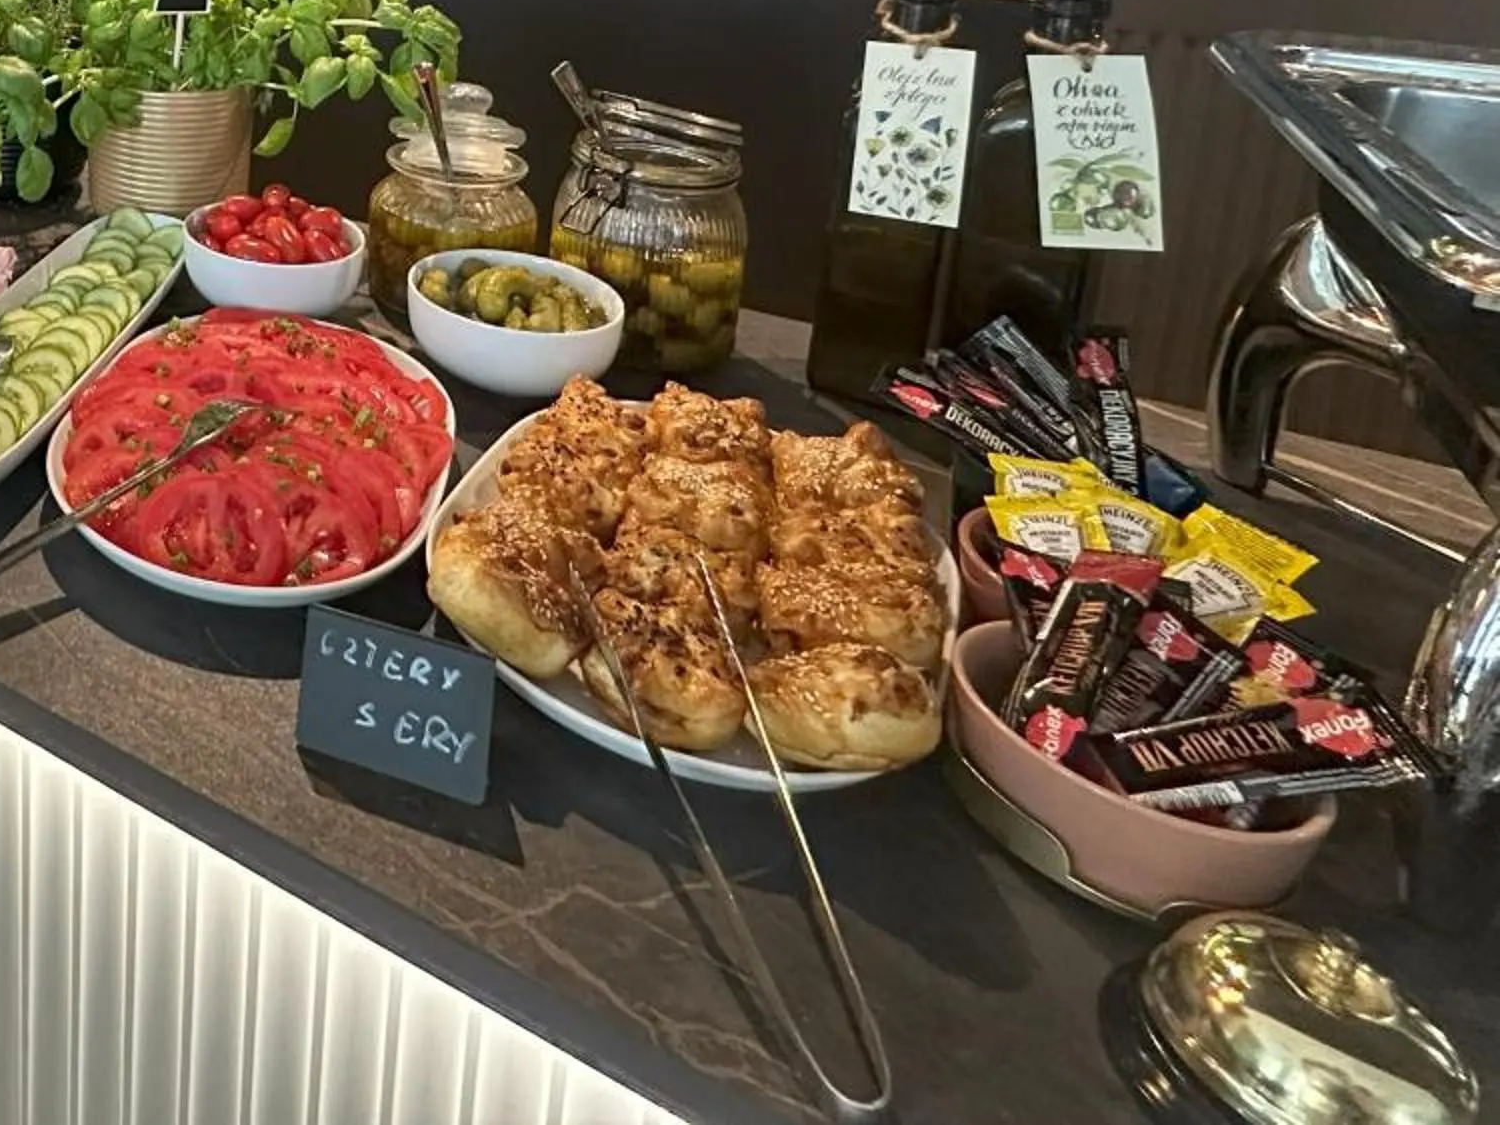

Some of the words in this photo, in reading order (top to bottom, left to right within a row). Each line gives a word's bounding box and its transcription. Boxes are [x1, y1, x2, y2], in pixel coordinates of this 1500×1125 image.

[944, 403, 1020, 458] DEKORACY
[320, 629, 463, 691] CZTERY
[1050, 618, 1096, 696] KETCHUP
[1265, 641, 1298, 683] Fan
[354, 701, 478, 765] SERY
[1180, 719, 1295, 764] KETCHUP
